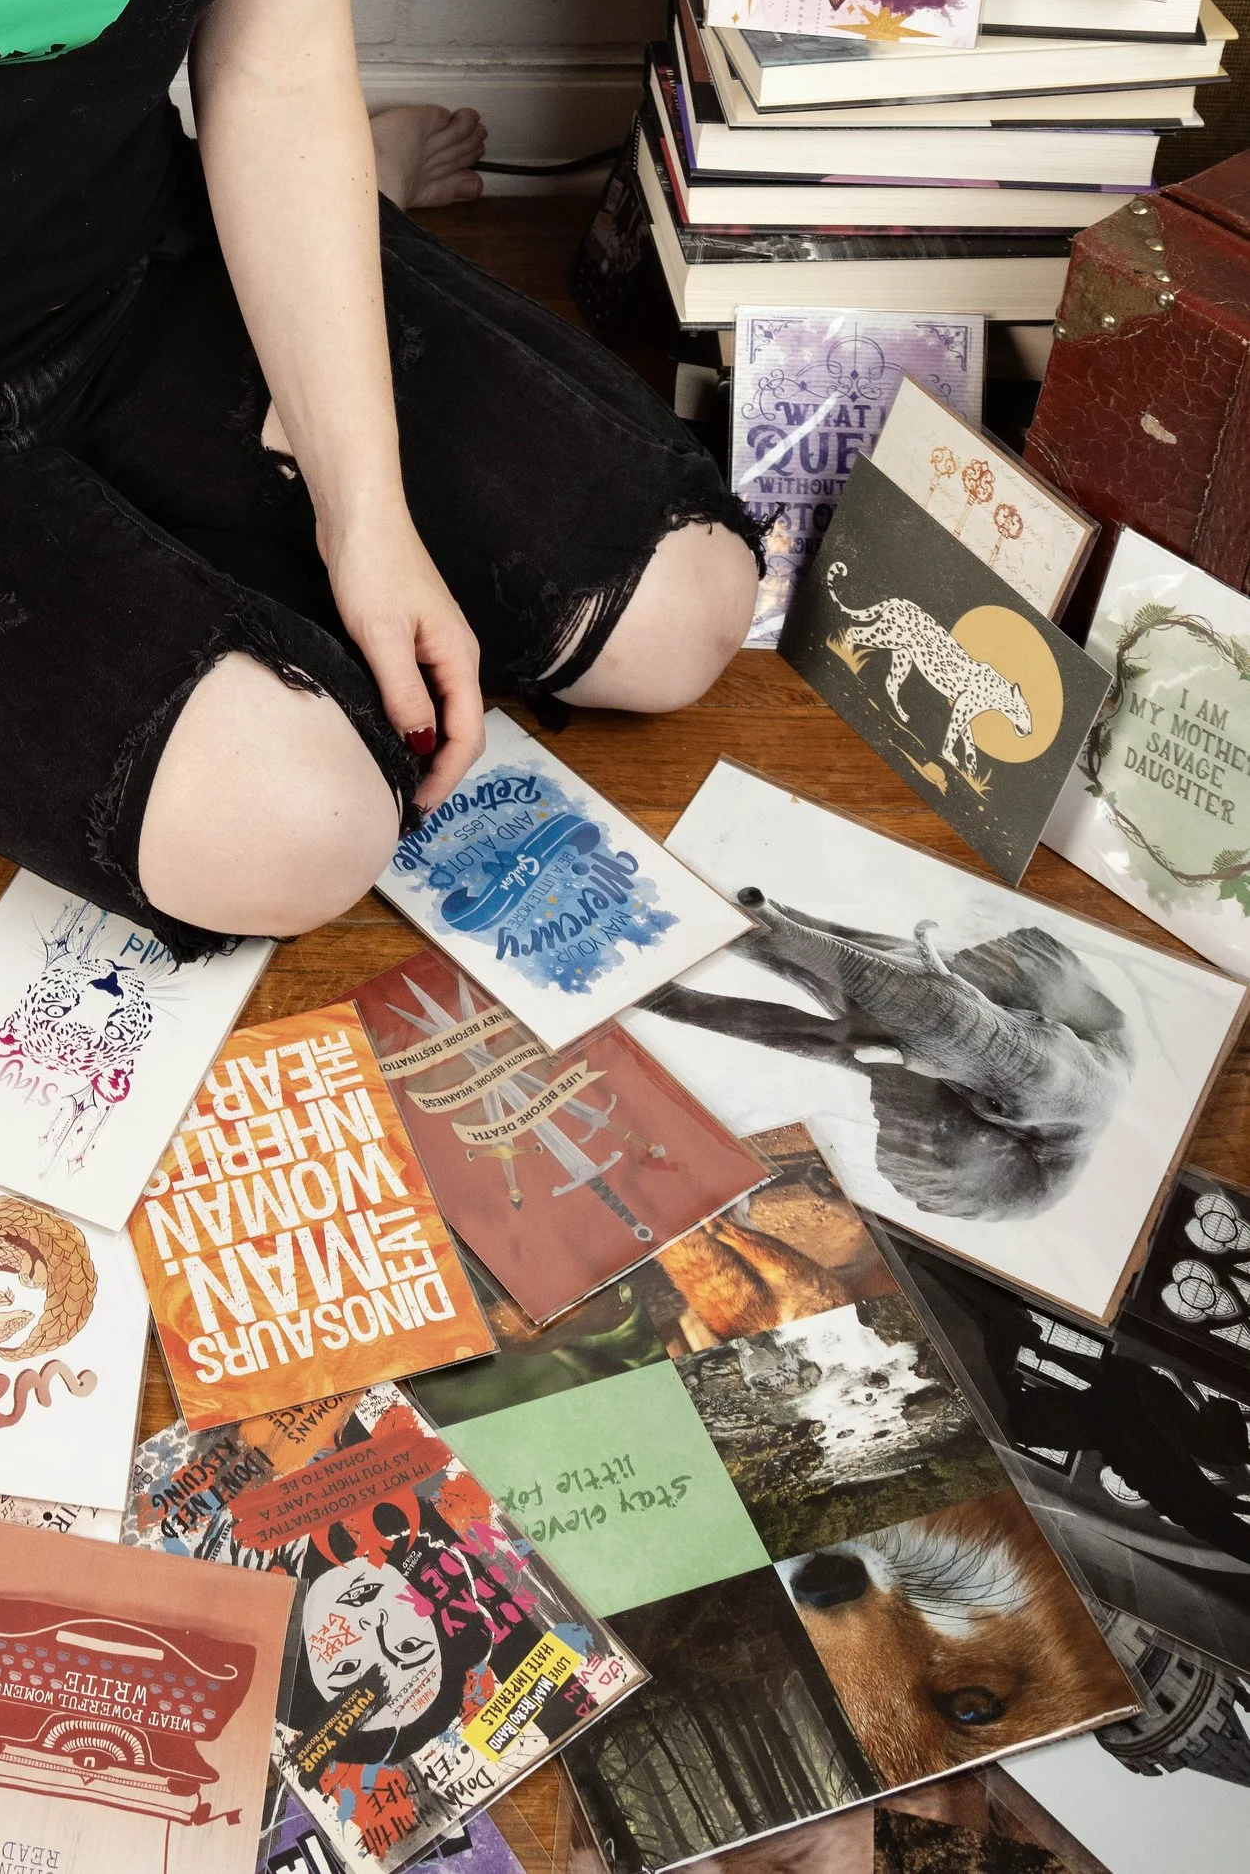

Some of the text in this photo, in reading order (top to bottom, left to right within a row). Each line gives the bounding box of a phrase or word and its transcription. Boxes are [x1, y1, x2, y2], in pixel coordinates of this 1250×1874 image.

[1129, 692, 1165, 726] MY
[1195, 699, 1230, 731] AM
[1124, 746, 1235, 825] DAUGHTER
[1146, 732, 1226, 790] SAVAGE
[448, 810, 535, 874] AND A LOT
[500, 854, 540, 891] Sailor
[495, 850, 639, 960] Mercury
[506, 874, 559, 929] LITTLE MORE
[557, 910, 631, 965] MAY YOUR
[446, 1023, 481, 1047] BEFORE
[311, 1030, 364, 1096] THE
[418, 1064, 507, 1109] BEFORE WEAKNESS,
[468, 1072, 583, 1141] LIFE BEFORE DEATH,
[144, 1143, 409, 1257] WOMAN
[370, 1206, 438, 1284] EAT
[188, 1272, 456, 1384] DINOSAURS
[152, 1436, 239, 1514] RESCUING
[277, 1459, 392, 1517] YOU MIGHT WANT
[324, 1447, 378, 1476] WOMAN
[384, 1473, 411, 1492] NOT
[556, 1453, 635, 1495] little
[160, 1492, 212, 1539] NEED
[256, 1491, 358, 1543] COOPERATIVE
[619, 1474, 692, 1514] stay
[1, 1682, 191, 1732] WHAT POWERFUL WOMEN
[63, 1671, 148, 1706] WRITE
[341, 1689, 361, 1709] LOCAL
[411, 1688, 436, 1713] AVENGE
[480, 1642, 555, 1726] HATE IMPERIALS
[488, 1656, 571, 1751] LOVE MAX REBO BAND
[301, 1688, 375, 1773] PUNCH YOUR
[1, 1841, 61, 1869] READ
